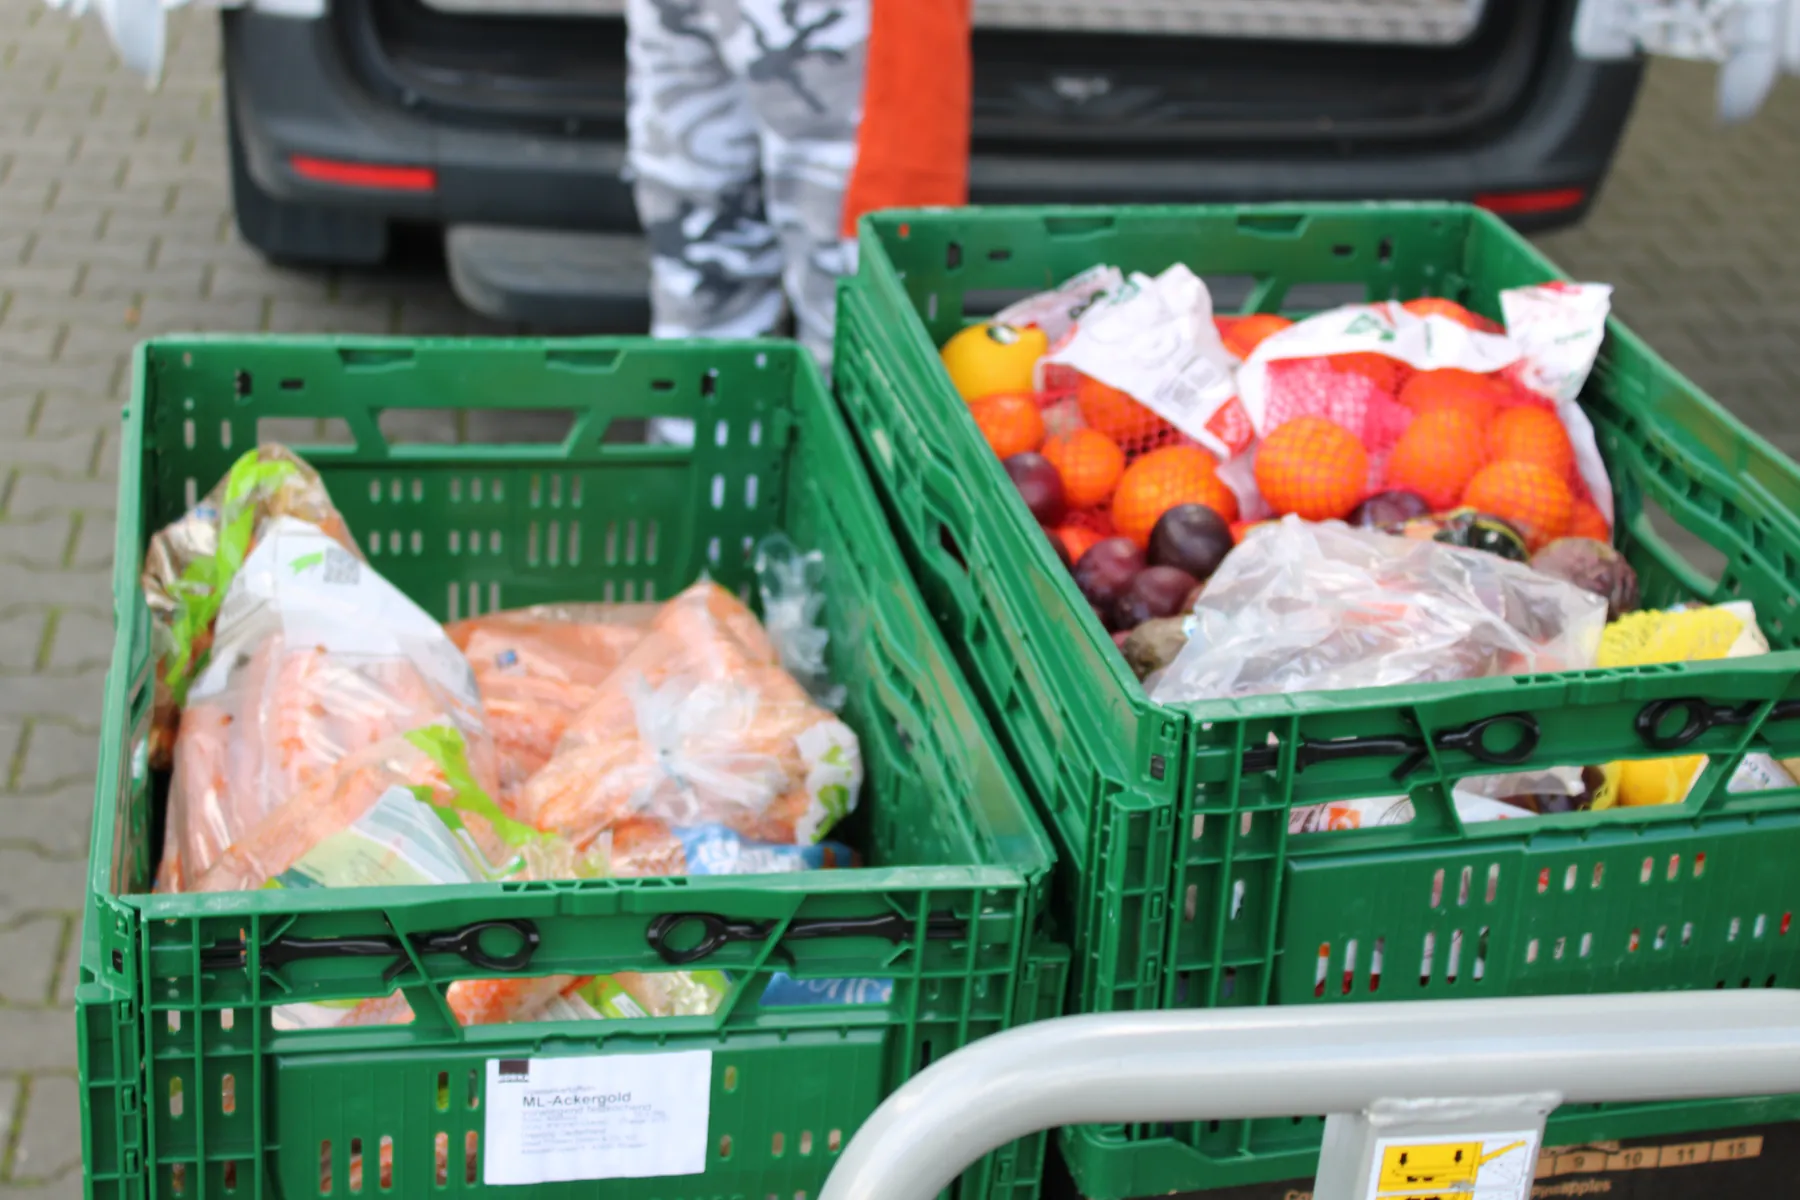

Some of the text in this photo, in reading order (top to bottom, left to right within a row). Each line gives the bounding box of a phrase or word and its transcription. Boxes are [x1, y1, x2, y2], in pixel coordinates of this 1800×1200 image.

[522, 1091, 632, 1108] ML-Ackergold
[1623, 1151, 1643, 1168] 10
[1676, 1147, 1695, 1162] 11
